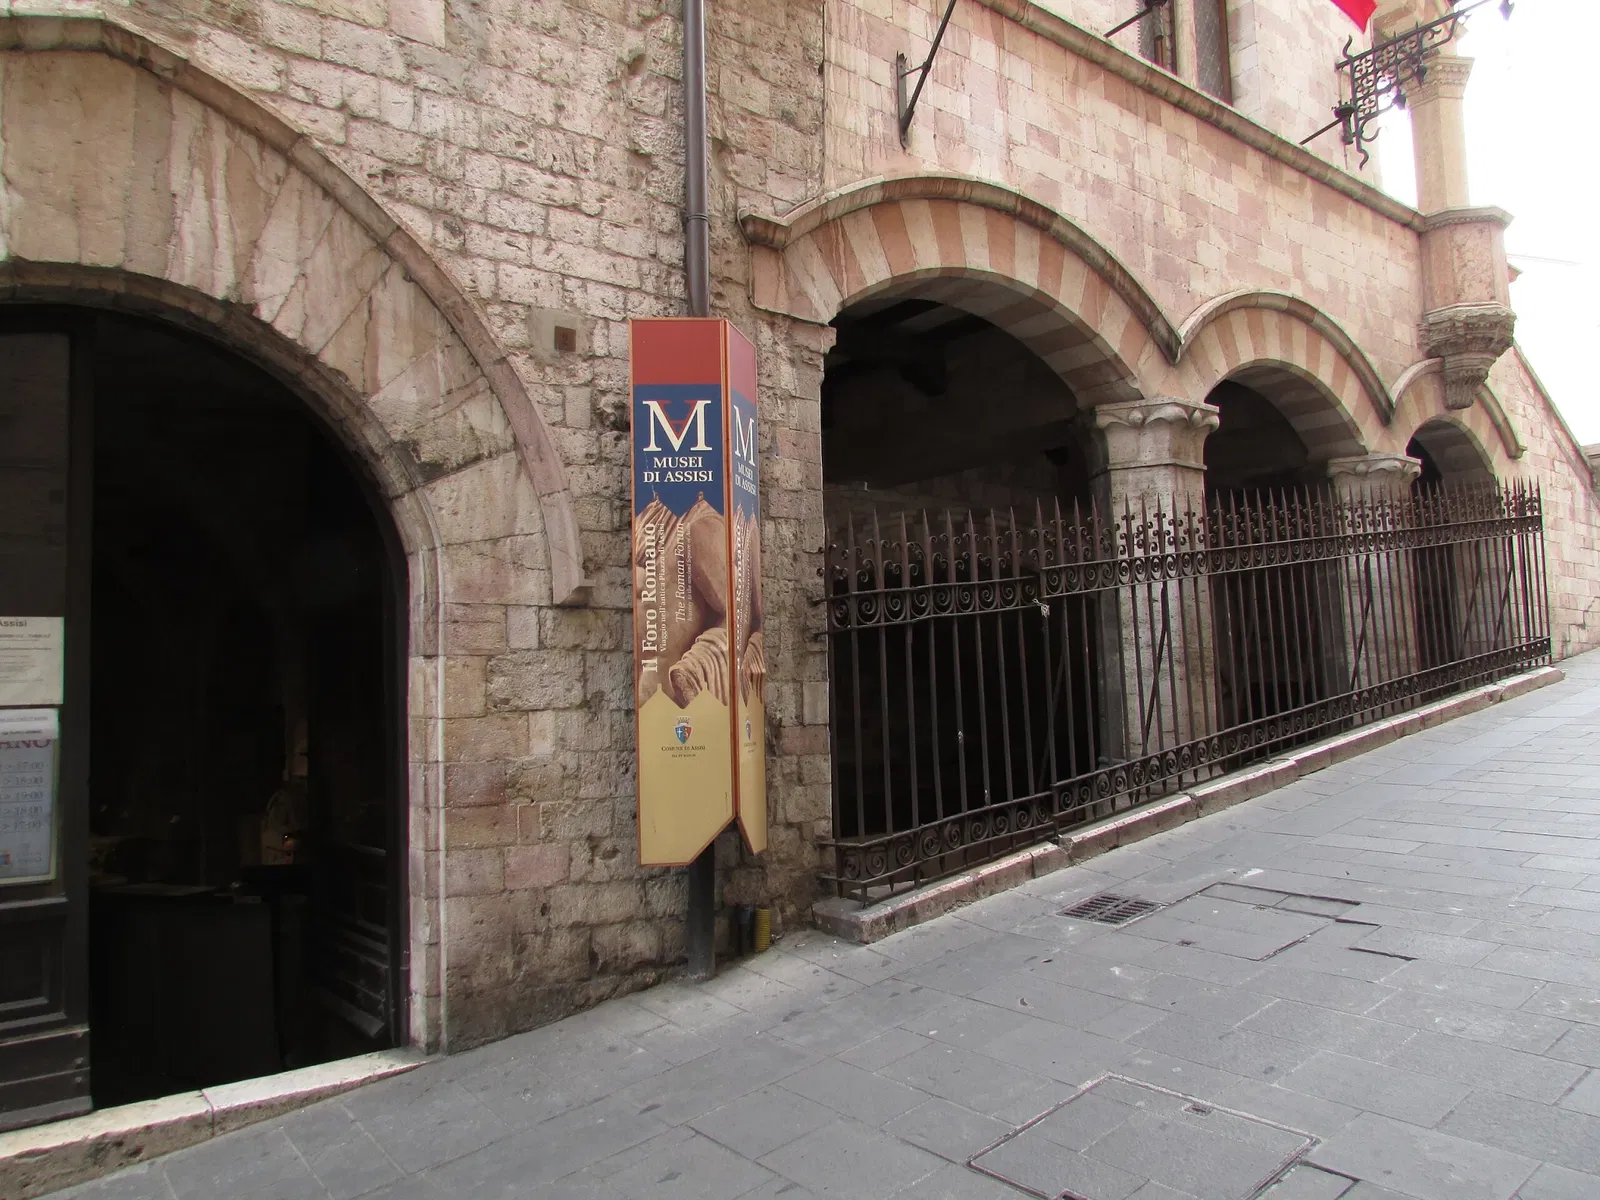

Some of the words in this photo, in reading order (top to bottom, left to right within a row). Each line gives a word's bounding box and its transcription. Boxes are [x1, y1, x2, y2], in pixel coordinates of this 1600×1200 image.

[653, 456, 704, 469] MUSEI
[737, 461, 754, 482] MUSEI
[643, 471, 661, 483] DI
[664, 470, 714, 482] ASSISI
[735, 473, 743, 488] DI
[741, 476, 757, 496] ASSISI
[658, 546, 665, 555] di
[674, 523, 685, 557] Forum
[641, 523, 657, 603] Romano
[658, 556, 666, 581] Piazza
[675, 560, 686, 600] Roman
[675, 602, 686, 622] The
[641, 608, 658, 652] Foro
[659, 623, 668, 652] Viaggio
[641, 657, 658, 673] Il
